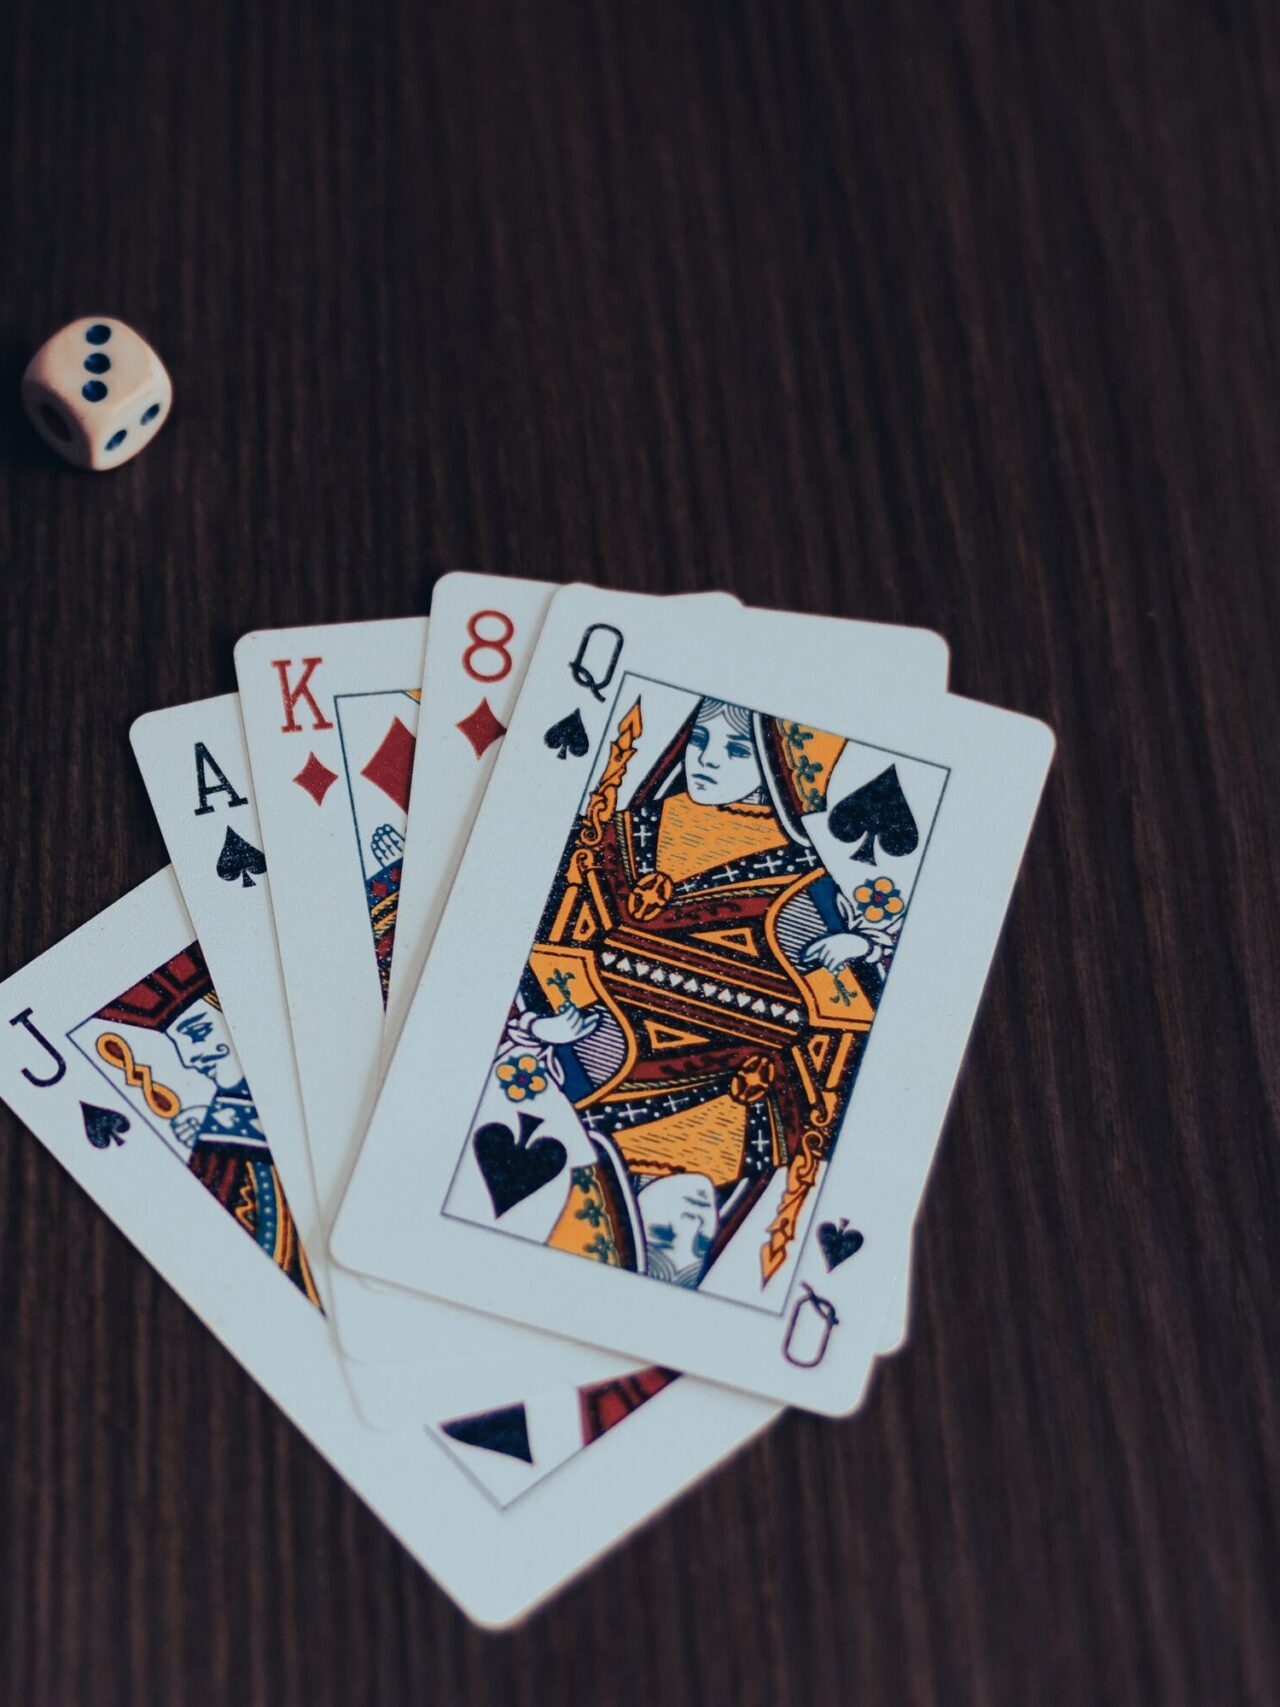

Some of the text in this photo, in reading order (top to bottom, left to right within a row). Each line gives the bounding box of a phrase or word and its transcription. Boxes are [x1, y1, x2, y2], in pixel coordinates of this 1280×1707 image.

[462, 609, 515, 684] 8
[567, 623, 626, 703] Q
[272, 657, 334, 733] K
[194, 741, 249, 816] A
[8, 1007, 68, 1088] J
[782, 1280, 841, 1369] Q
